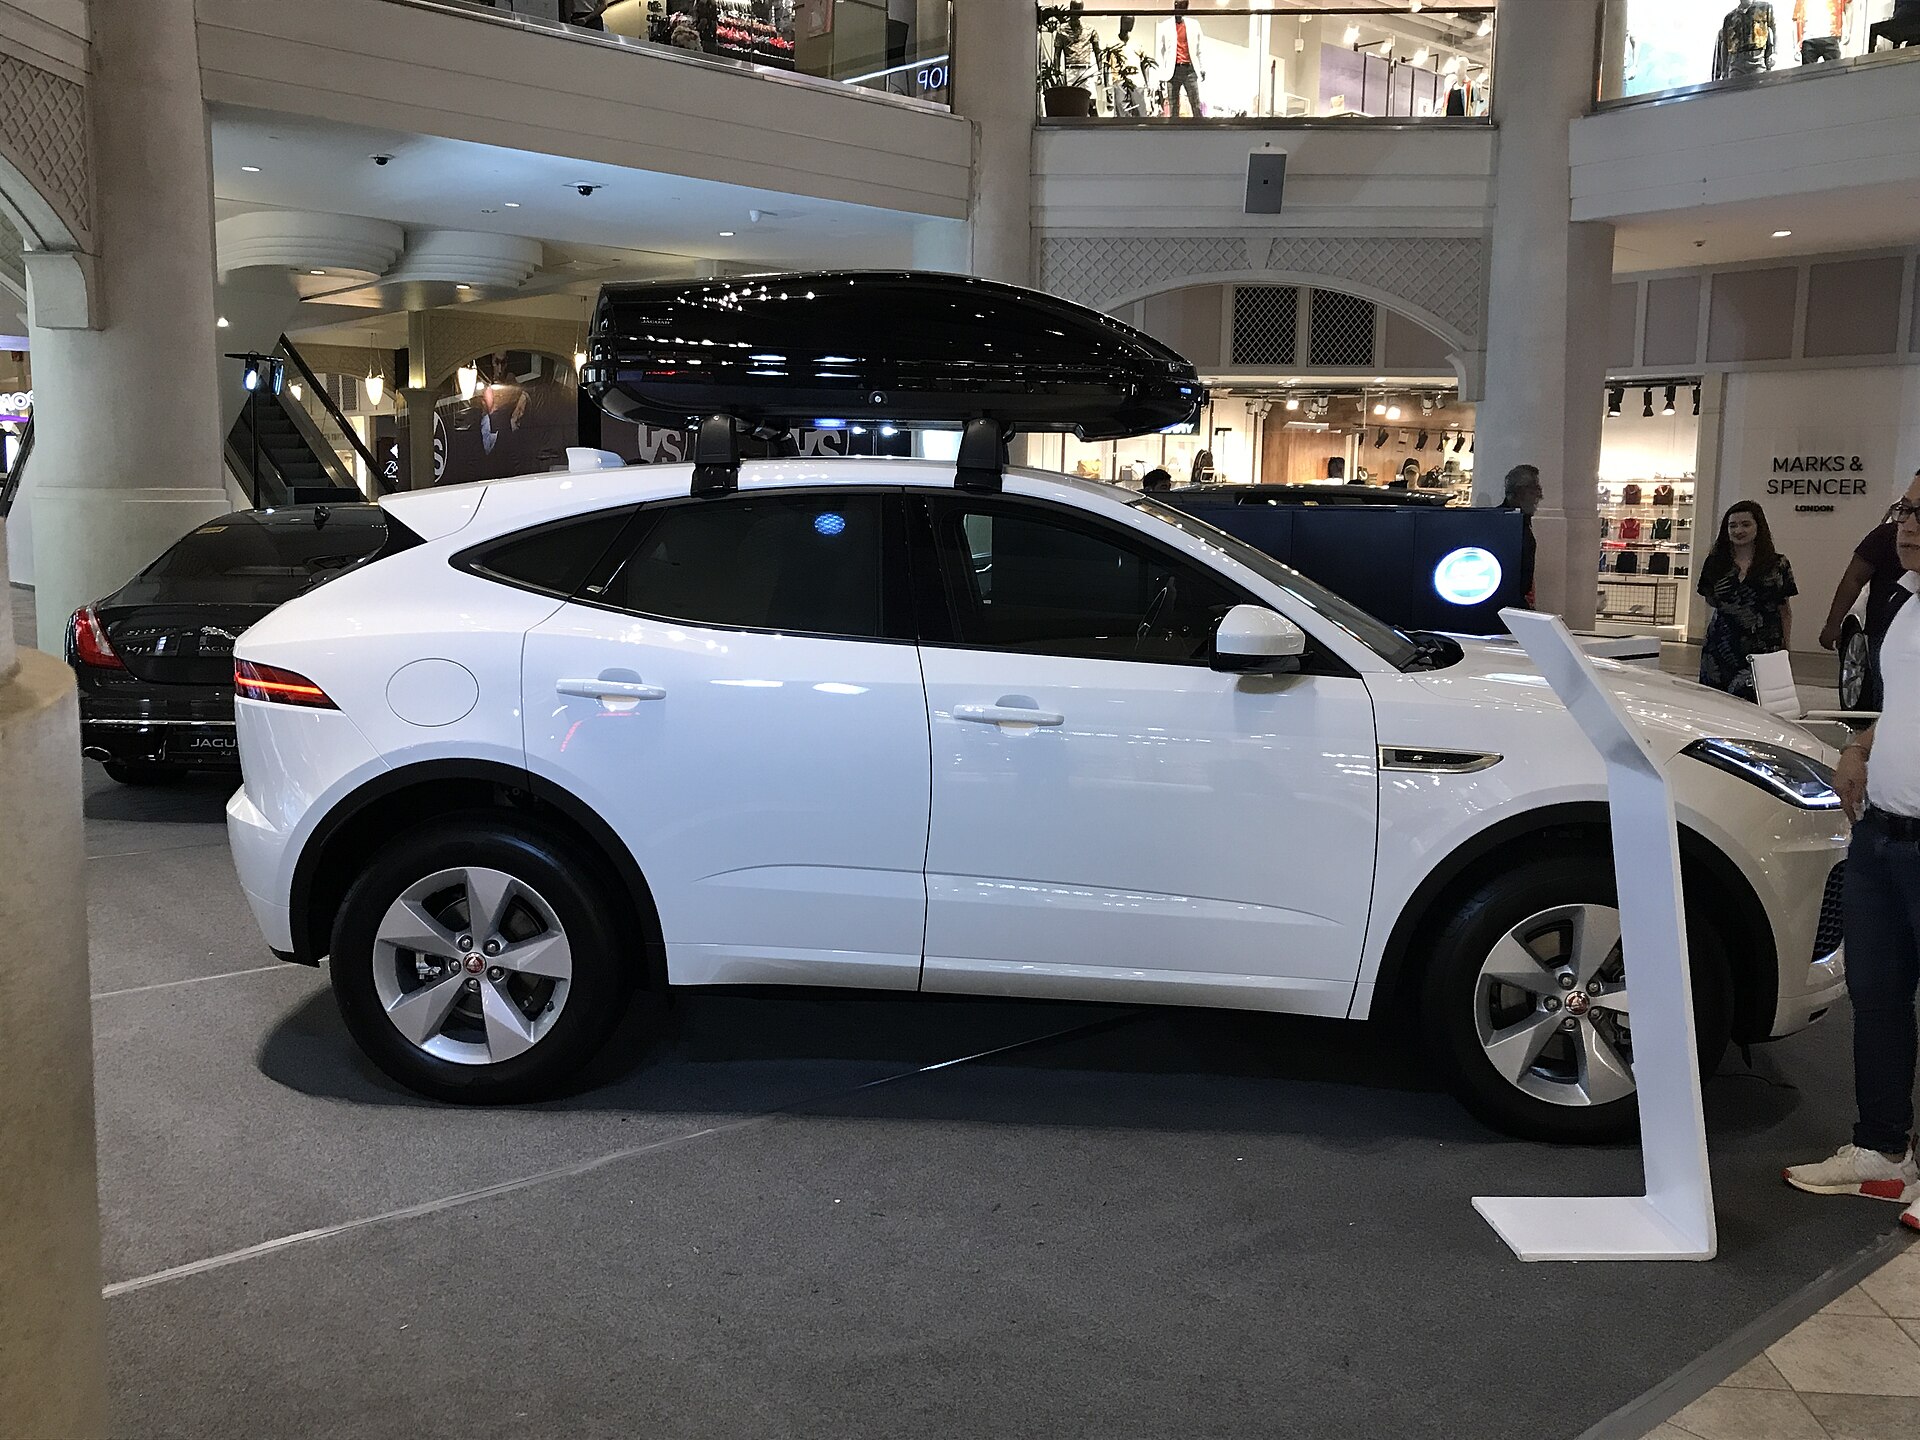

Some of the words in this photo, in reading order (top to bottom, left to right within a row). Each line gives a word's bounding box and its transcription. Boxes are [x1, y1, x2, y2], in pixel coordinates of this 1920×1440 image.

[1773, 456, 1845, 472] MARKS
[1849, 456, 1863, 471] &
[1766, 479, 1867, 495] SPENCER
[190, 739, 237, 747] JAGU
